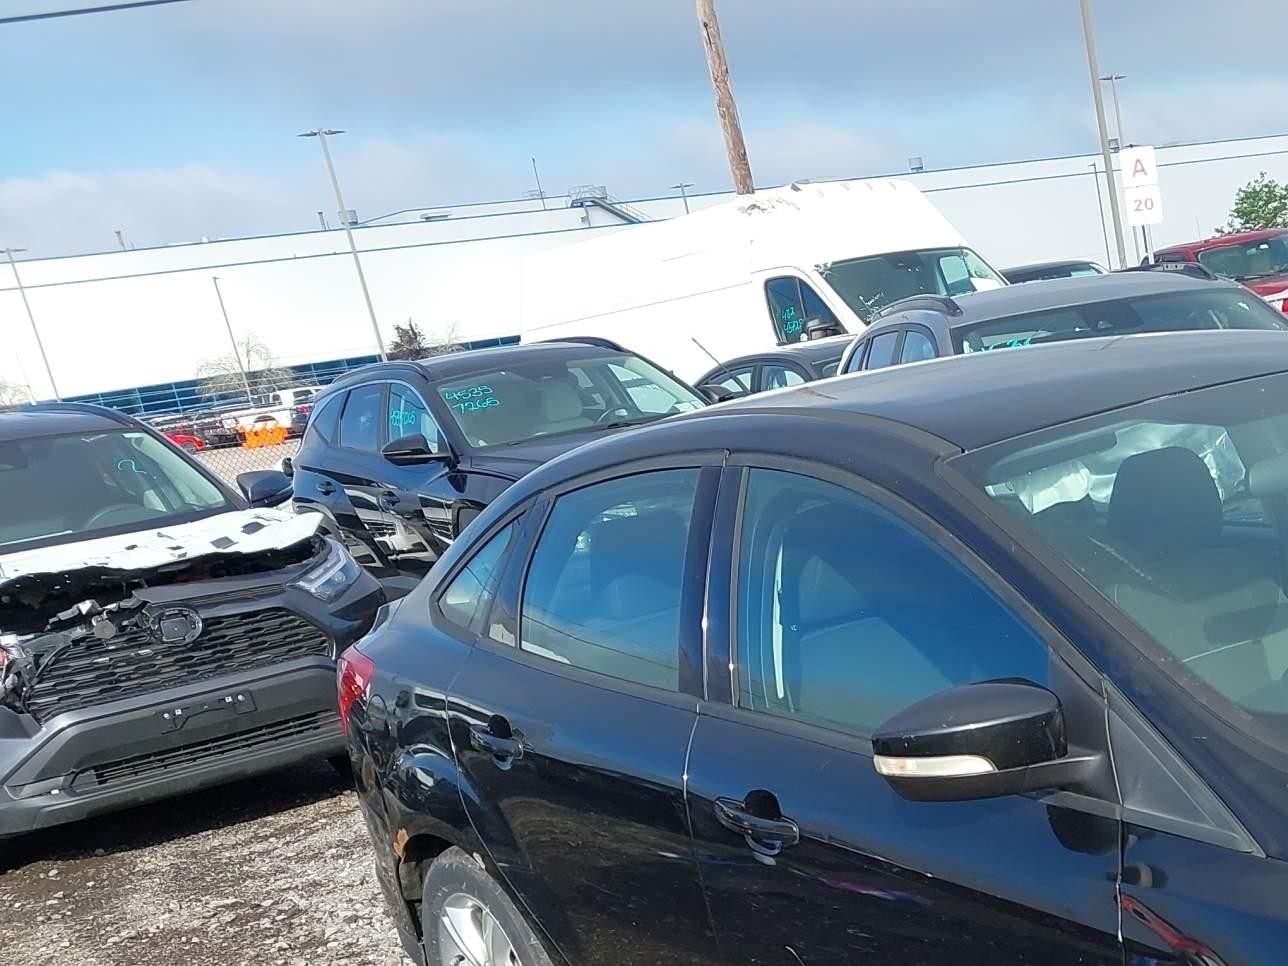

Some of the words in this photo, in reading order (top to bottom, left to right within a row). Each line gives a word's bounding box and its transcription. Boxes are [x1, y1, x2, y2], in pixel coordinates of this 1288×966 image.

[1132, 158, 1148, 178] A
[1133, 197, 1154, 212] 20
[445, 385, 493, 401] 4535
